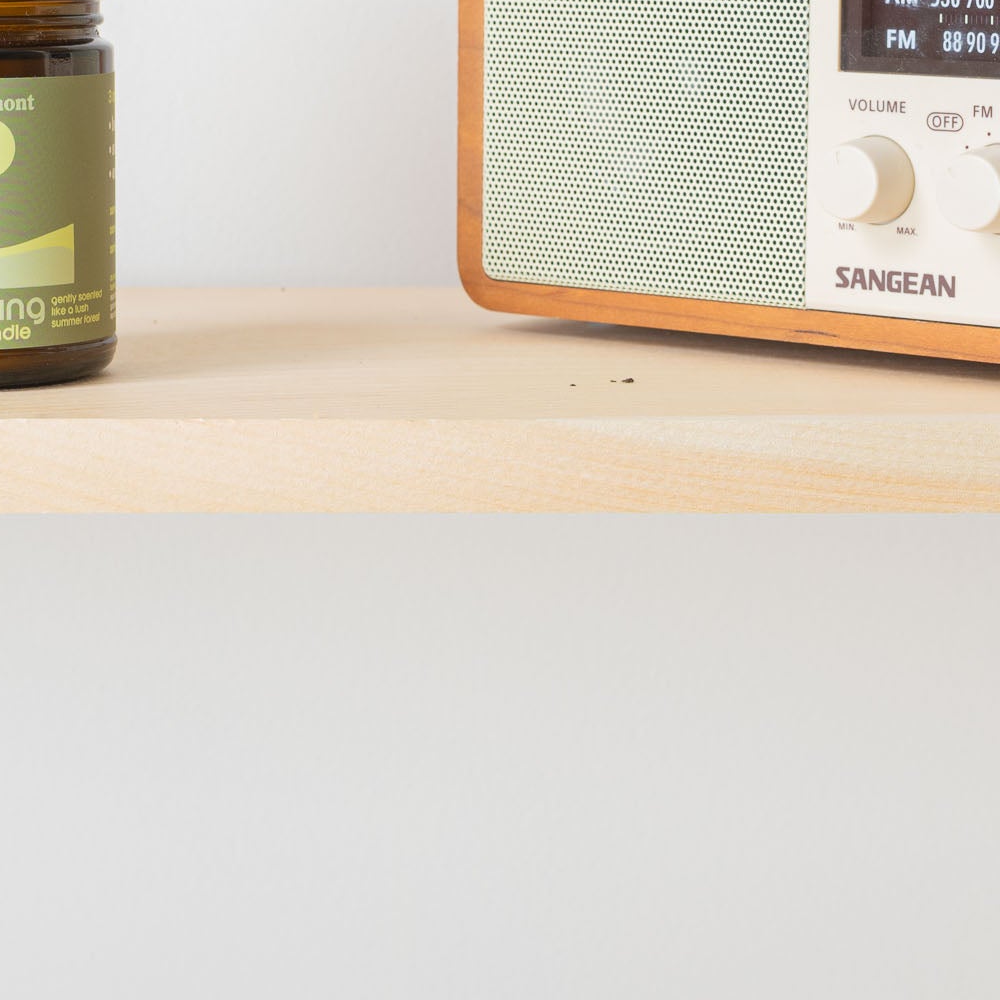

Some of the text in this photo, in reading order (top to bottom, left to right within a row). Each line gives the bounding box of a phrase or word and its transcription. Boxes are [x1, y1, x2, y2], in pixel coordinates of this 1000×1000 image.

[886, 29, 916, 50] FM
[942, 31, 962, 52] 88
[966, 32, 986, 53] 90
[848, 98, 907, 114] VOLUME
[973, 105, 993, 118] FM
[932, 115, 958, 129] OFF
[835, 266, 956, 298] SANGEAN
[51, 289, 103, 306] gently scented
[51, 303, 89, 316] like a lush
[51, 315, 83, 328] summer
